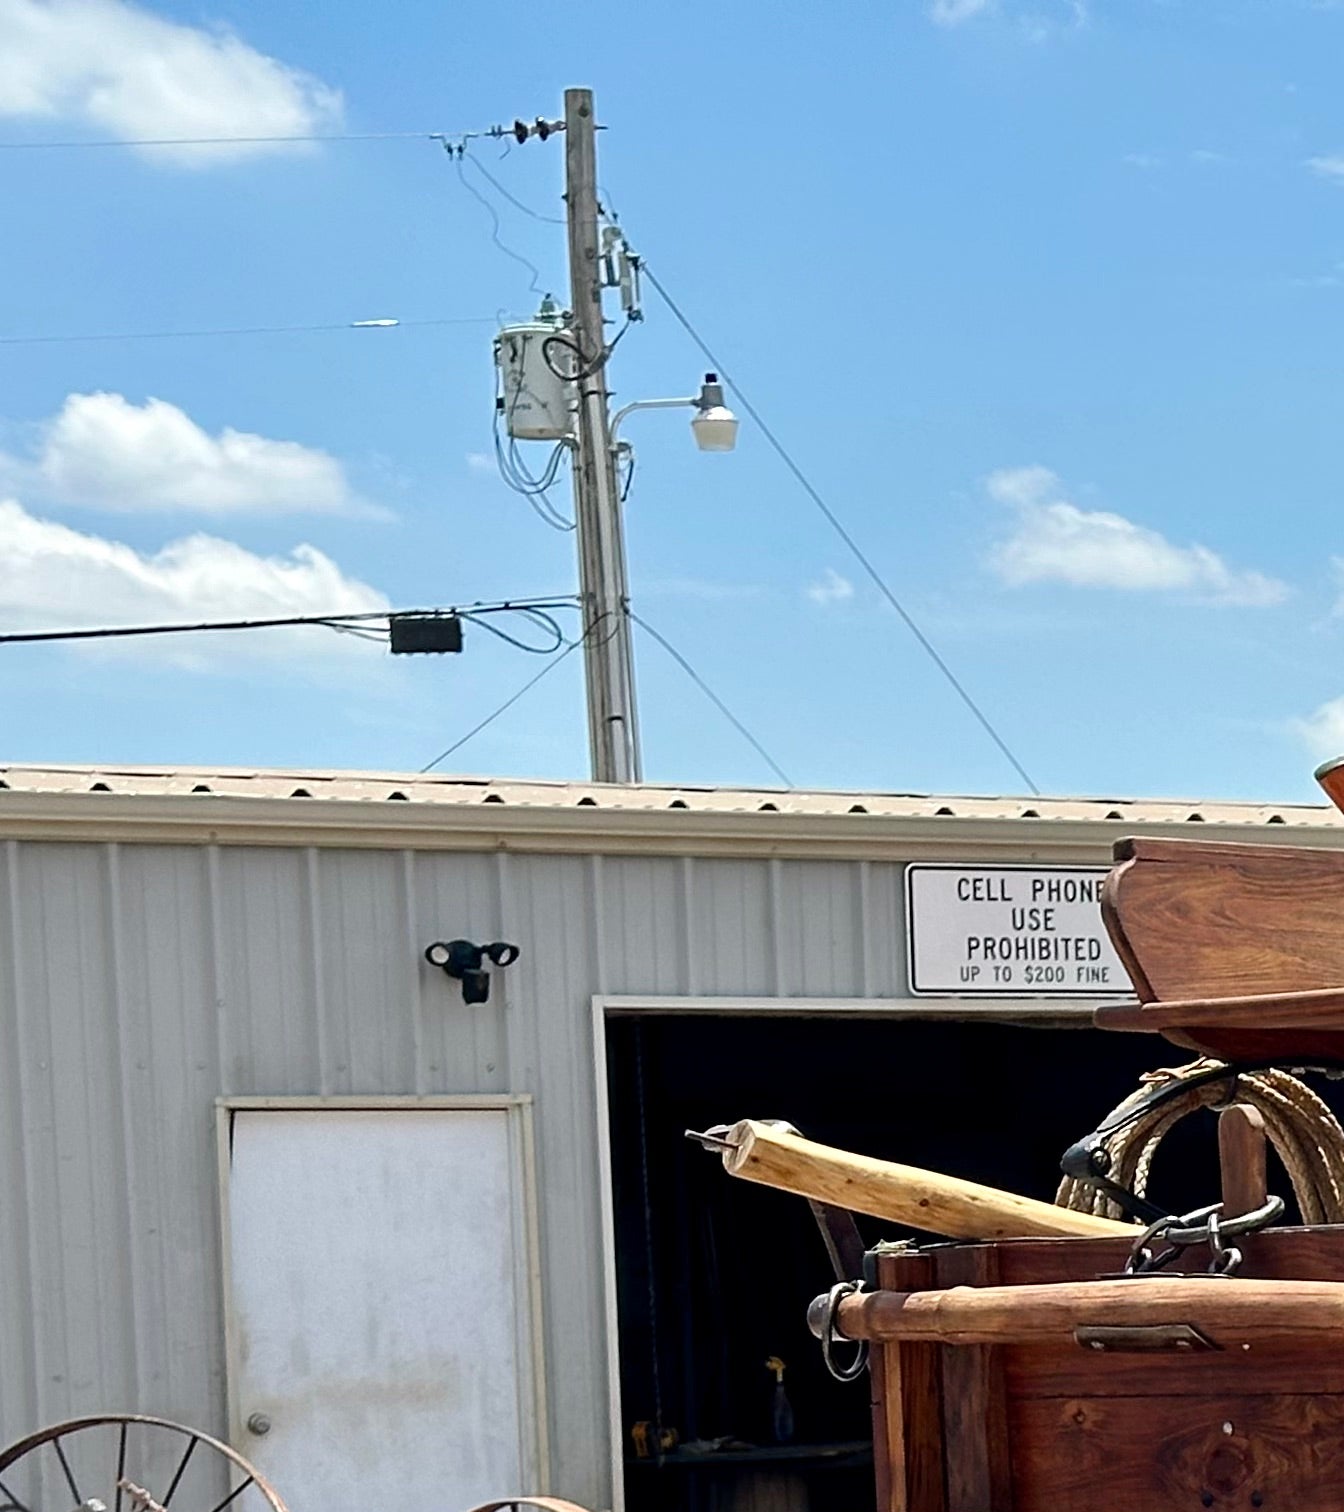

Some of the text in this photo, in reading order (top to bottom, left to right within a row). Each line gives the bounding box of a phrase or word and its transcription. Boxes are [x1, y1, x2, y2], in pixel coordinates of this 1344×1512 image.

[957, 877, 1105, 903] CELL PHONE
[1011, 907, 1056, 931] USE
[967, 936, 1101, 961] PROHIBITED
[960, 965, 1110, 984] UP TO $200 FINE
